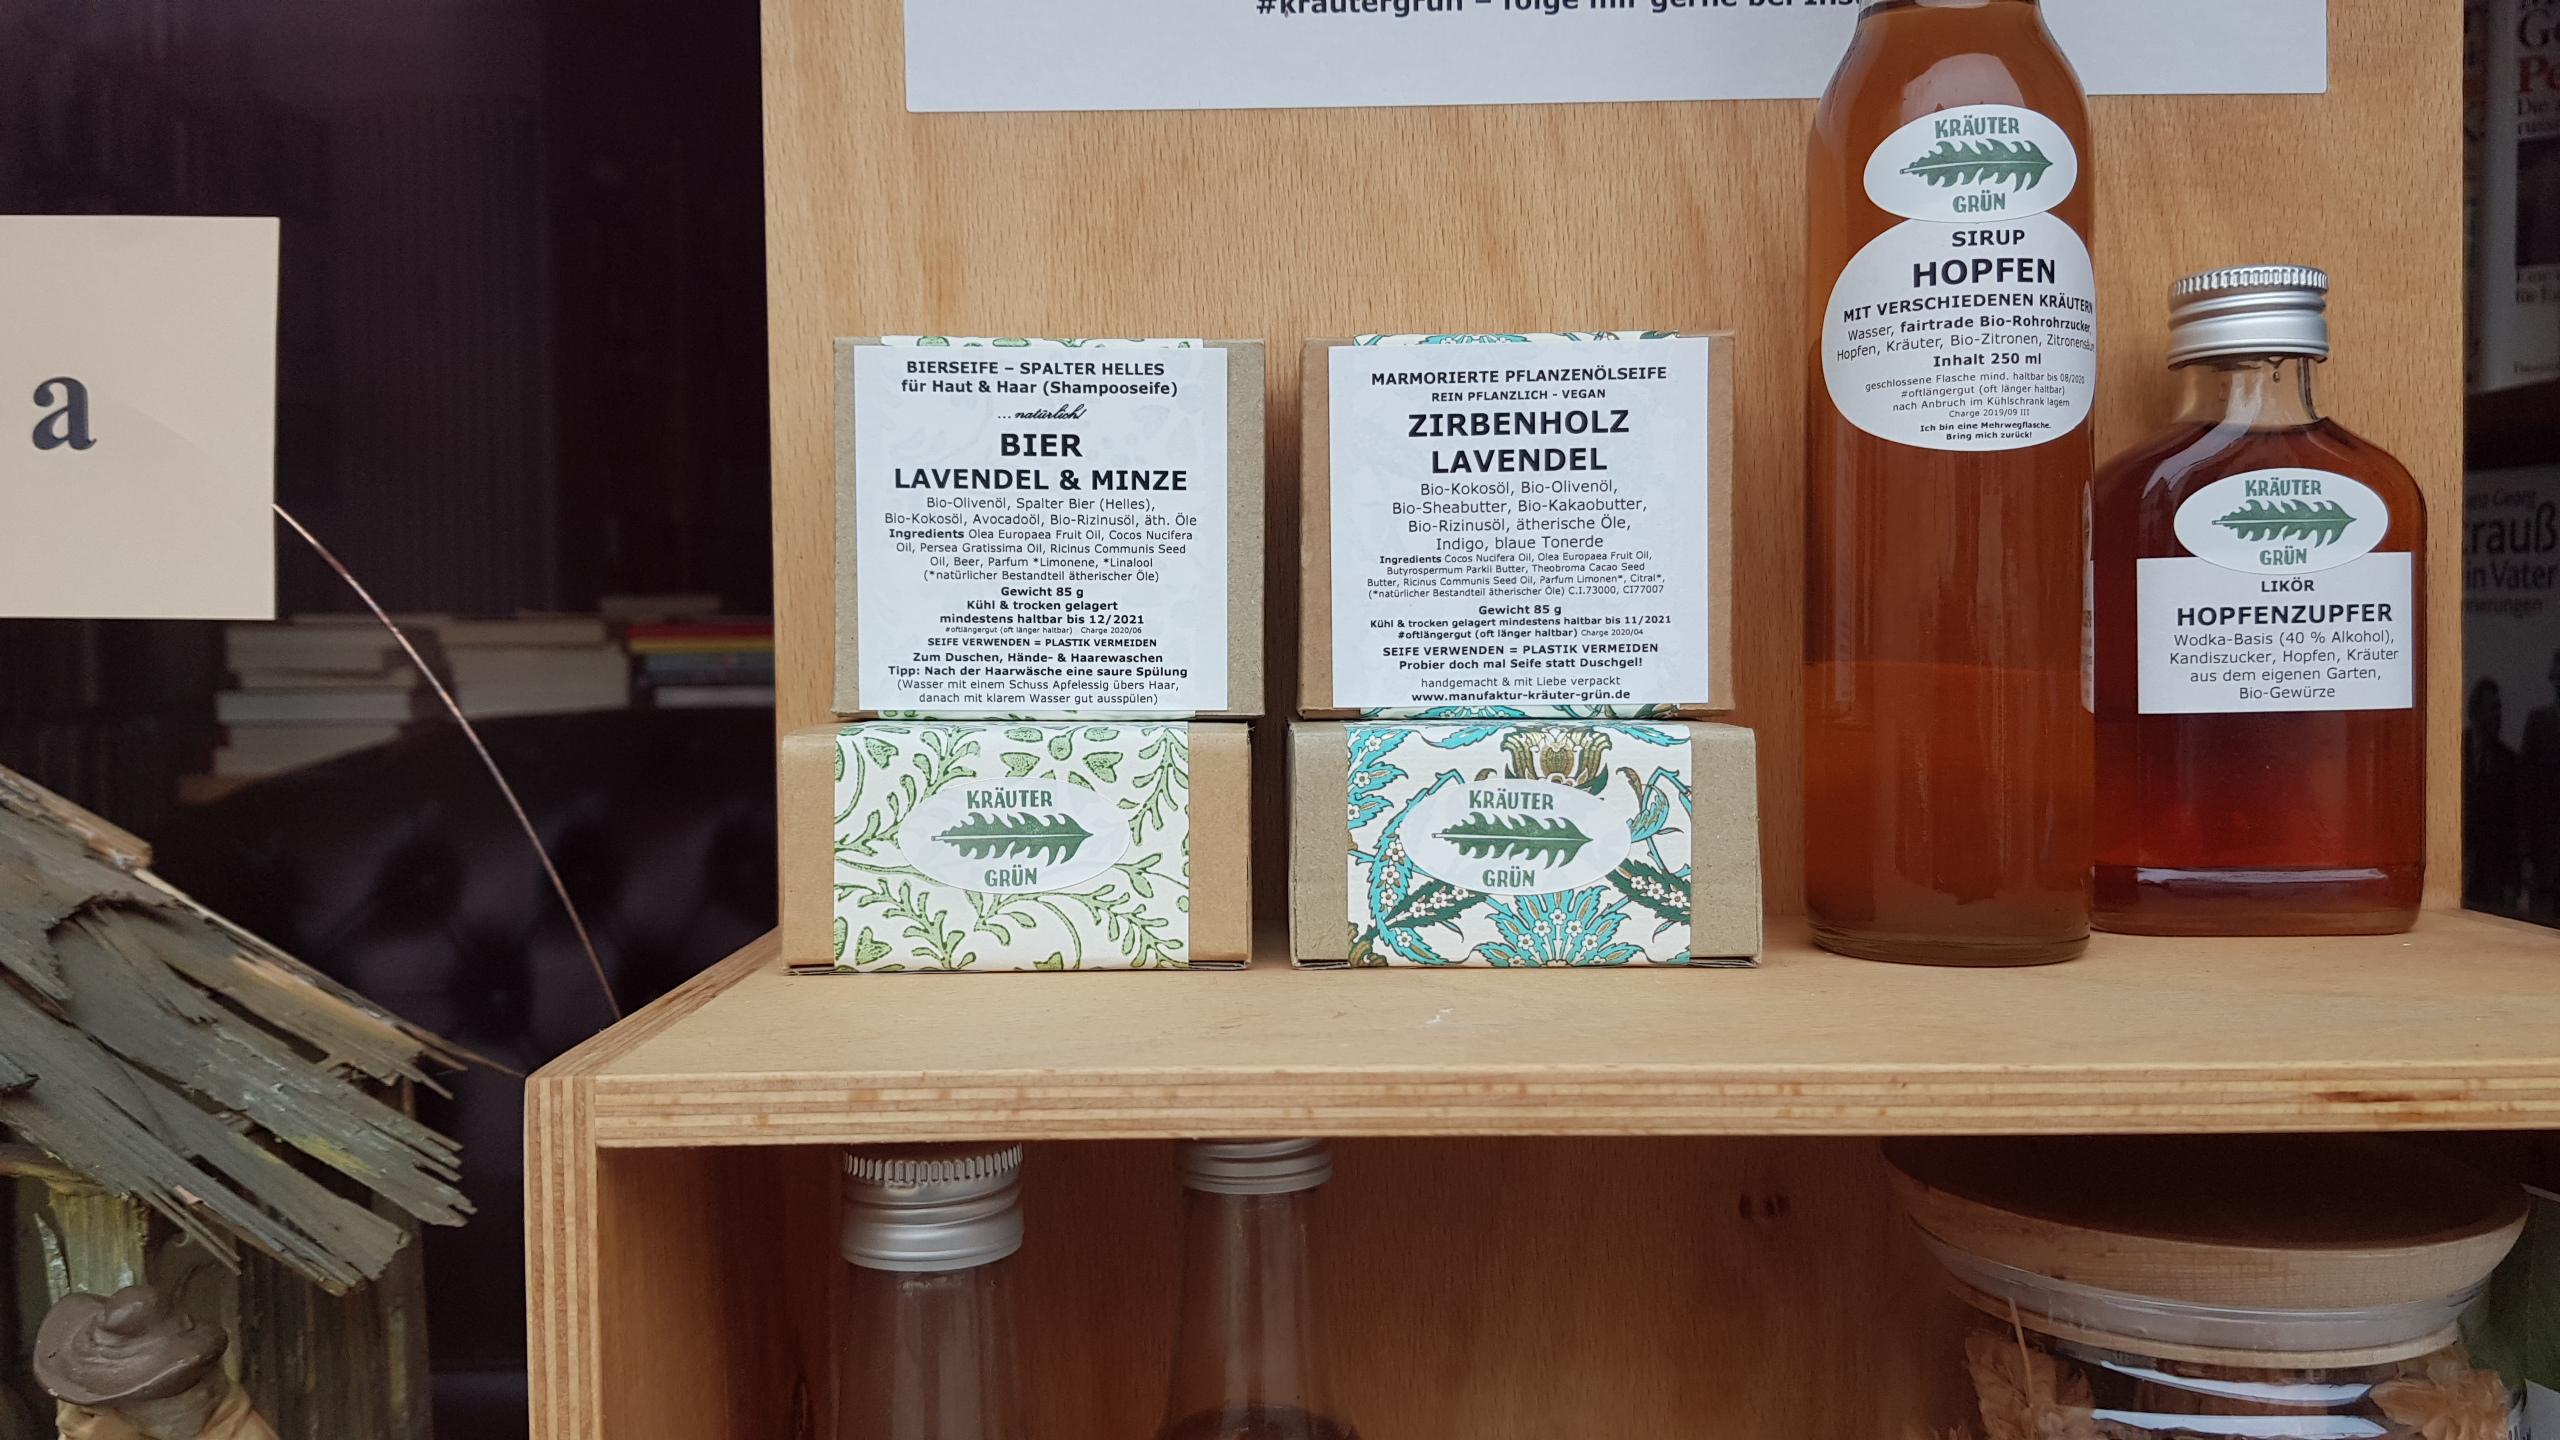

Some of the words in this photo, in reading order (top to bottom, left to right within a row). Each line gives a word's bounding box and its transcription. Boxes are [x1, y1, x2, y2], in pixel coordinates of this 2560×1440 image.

[1935, 117, 2020, 139] KRÄUTER
[1952, 189, 2006, 213] GRÜN
[1952, 229, 2025, 247] SIRUP
[1913, 258, 2055, 288] HOPFEN
[1844, 306, 1871, 323] MIT
[1877, 293, 2034, 316] VERSCHIEDENEN
[2039, 292, 2093, 315] KRÄUTERN
[1848, 325, 1895, 341] Wasser,
[1900, 316, 1974, 333] fairtrade
[1837, 344, 1881, 361] Hopfen,
[1886, 337, 1944, 352] Kräuter,
[1951, 333, 2042, 347] Bio-Zitronen,
[1933, 354, 1985, 367] Inhalt
[1991, 352, 2020, 364] 250
[2025, 353, 2041, 364] ml
[907, 361, 998, 374] BIERSEIFE
[1020, 362, 1096, 375] SPALTER
[1102, 363, 1164, 376] HELLES
[1372, 370, 1499, 385] MARMORIERTE
[1505, 366, 1667, 382] PFLANZENÖLSEIFE
[901, 379, 927, 392] für
[932, 380, 973, 393] Haut
[978, 380, 991, 393] &
[997, 380, 1037, 393] Haar
[1043, 380, 1177, 397] (Shampooseife)
[1432, 392, 1463, 402] REIN
[1468, 390, 1548, 401] PFLANZLICH
[1562, 389, 1605, 399] VEGAN
[1901, 386, 1975, 398] #oftlängergut
[1979, 384, 1998, 395] (oft
[2001, 384, 2031, 394] länger
[2034, 384, 2065, 396] haltbar)
[32, 376, 97, 451] a
[1408, 409, 1629, 437] ZIRBENHOLZ
[1001, 433, 1083, 457] BIER
[1432, 447, 1607, 474] LAVENDEL
[895, 468, 1049, 490] LAVENDEL
[1059, 469, 1082, 490] &
[1092, 470, 1187, 491] MINZE
[1421, 481, 1514, 496] Bio-Kokosöl,
[1521, 479, 1617, 494] Bio-Olivenöl,
[2245, 477, 2321, 497] KRÄUTER
[927, 497, 1010, 511] Bio-Olivenöl,
[1016, 497, 1064, 511] Spalter
[1069, 498, 1095, 509] Bier
[1100, 498, 1155, 512] (Helles),
[1393, 501, 1511, 515] Bio-Sheabutter,
[1518, 498, 1647, 512] Bio-Kakaobutter,
[885, 512, 967, 526] Bio-Kokosöl,
[972, 513, 1044, 527] Avocadoöl,
[1050, 514, 1139, 528] Bio-Rizinusöl,
[1144, 514, 1170, 526] äth.
[1175, 512, 1197, 526] Öle
[1409, 518, 1510, 533] Bio-Rizinusöl,
[1516, 517, 1595, 531] ätherische
[1601, 514, 1630, 531] Öle,
[1436, 537, 1488, 553] Indigo,
[1495, 536, 1536, 550] blaue
[1541, 535, 1603, 548] Tonerde
[2259, 545, 2307, 566] GRÜN
[1002, 570, 1064, 581] Bestandteil
[1069, 571, 1133, 581] ätherischer
[1136, 570, 1159, 583] Öle)
[2261, 577, 2315, 592] LIKÖR
[1001, 586, 1052, 597] Gewicht
[1056, 587, 1072, 597] 85
[1076, 589, 1084, 599] g
[967, 600, 995, 610] Kühl
[1000, 600, 1009, 610] &
[1013, 600, 1061, 610] trocken
[1065, 601, 1118, 612] gelagert
[1478, 605, 1530, 615] Gewicht
[1534, 604, 1550, 614] 85
[1554, 606, 1562, 616] g
[2177, 603, 2393, 626] HOPFENZUPFER
[940, 613, 1013, 624] mindestens
[1017, 614, 1063, 624] haltbar
[1067, 614, 1085, 624] bis
[1090, 614, 1144, 626] 12/2021
[928, 637, 959, 646] SEIFE
[962, 638, 1030, 647] VERWENDEN
[1045, 638, 1090, 647] PLASTIK
[1093, 638, 1157, 647] VERMEIDEN
[2174, 633, 2273, 646] Wodka-Basis
[2280, 632, 2304, 647] (40
[2311, 631, 2325, 643] %
[2331, 629, 2394, 645] Alkohol),
[913, 652, 941, 662] Zum
[945, 652, 1003, 664] Duschen,
[1008, 652, 1053, 662] Hände-
[1057, 653, 1067, 663] &
[1071, 653, 1163, 663] Haarewaschen
[1383, 647, 1419, 656] SEIFE
[1423, 645, 1504, 656] VERWENDEN
[1523, 644, 1578, 654] PLASTIK
[1582, 643, 1658, 653] VERMEIDEN
[2170, 651, 2276, 665] Kandiszucker,
[2283, 649, 2340, 665] Hopfen,
[2347, 648, 2399, 661] Kräuter
[888, 665, 920, 677] Tipp:
[925, 666, 956, 676] Nach
[960, 666, 981, 676] der
[985, 666, 1062, 676] Haarwäsche
[1066, 666, 1093, 676] eine
[1097, 668, 1132, 676] saure
[1136, 666, 1187, 678] Spülung
[1399, 660, 1445, 670] Probier
[1449, 659, 1479, 669] doch
[1483, 659, 1506, 669] mal
[1510, 658, 1542, 668] Seife
[1545, 658, 1576, 668] statt
[1580, 657, 1642, 669] Duschgel!
[1421, 677, 1498, 689] handgemacht
[1502, 677, 1510, 686] &
[1514, 677, 1532, 686] mit
[1537, 676, 1567, 686] Liebe
[1570, 676, 1620, 687] verpackt
[2190, 672, 2217, 682] aus
[2223, 669, 2256, 682] dem
[2262, 668, 2320, 684] eigenen
[2327, 667, 2381, 681] Garten,
[897, 679, 944, 691] (Wasser
[948, 680, 967, 689] mit
[970, 680, 1005, 689] einem
[1009, 679, 1048, 689] Schuss
[1052, 680, 1109, 692] Apfelessig
[1113, 680, 1145, 690] übers
[1149, 680, 1178, 691] Haar,
[2240, 686, 2335, 699] Bio-Gewürze
[919, 693, 960, 703] danach
[964, 693, 983, 703] mit
[987, 693, 1025, 703] klarem
[1029, 693, 1071, 703] Wasser
[1074, 694, 1093, 705] gut
[1097, 693, 1158, 706] ausspülen)
[1411, 689, 1630, 701] www.manufaktur-kräuter-grün.de
[967, 787, 1053, 809] KRÄUTER
[1469, 788, 1554, 810] KRÄUTER
[984, 864, 1037, 887] GRÜN
[1482, 866, 1535, 888] GRÜN
